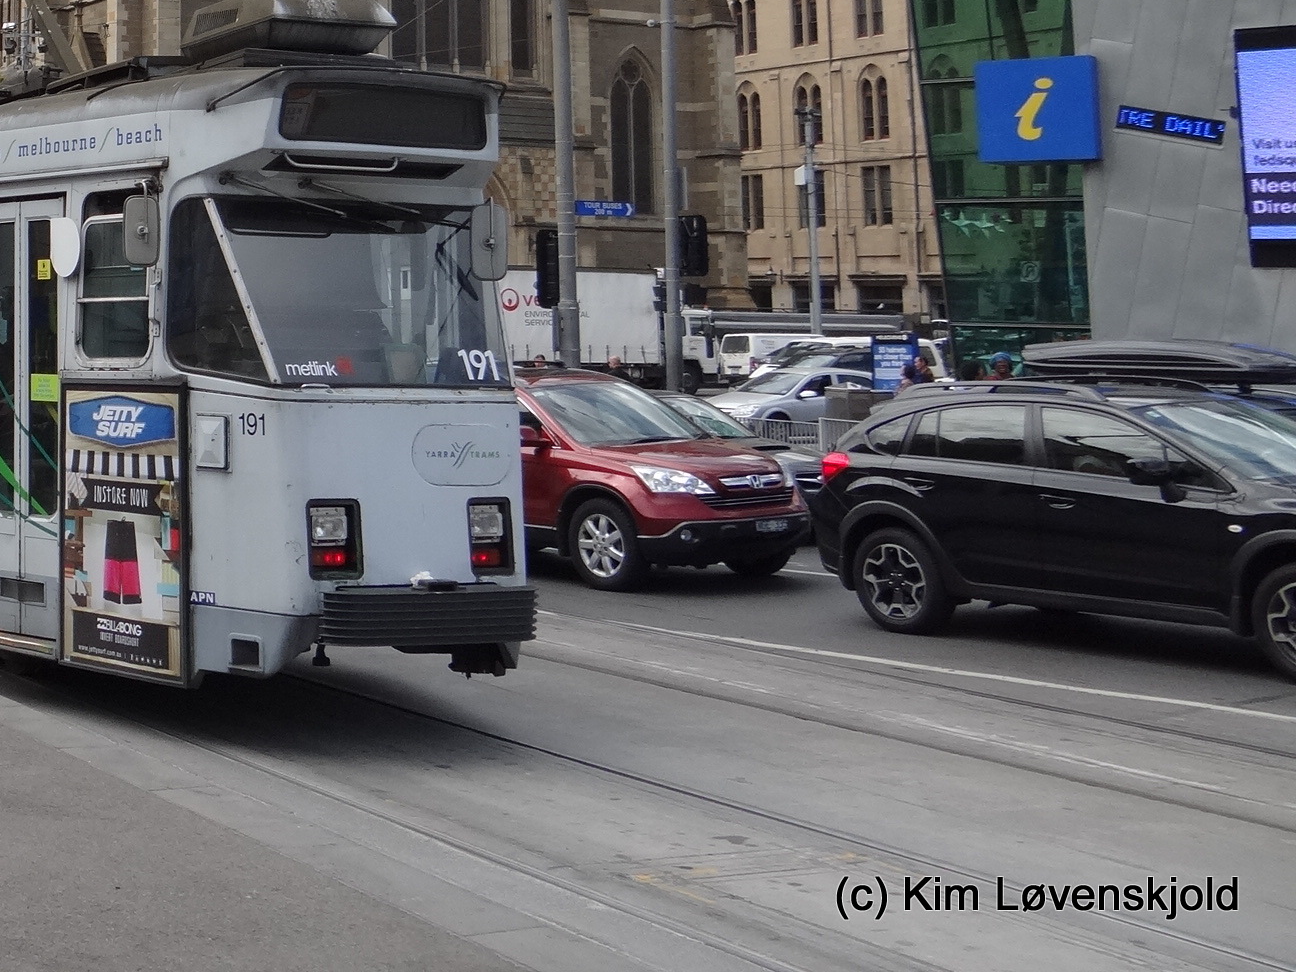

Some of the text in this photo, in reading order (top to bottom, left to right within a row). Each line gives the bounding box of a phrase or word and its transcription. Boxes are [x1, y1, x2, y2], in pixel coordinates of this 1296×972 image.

[1165, 116, 1225, 140] DAIL
[18, 135, 97, 158] melbourne
[116, 123, 163, 147] beach
[584, 201, 622, 210] TOUR BUSES
[285, 359, 338, 377] metlink
[458, 348, 500, 381] 191
[93, 405, 145, 422] JETTY
[95, 421, 146, 438] SURF
[238, 412, 266, 436] 191
[425, 450, 501, 459] YARRA TRAMS
[93, 485, 149, 508] INSTORE NOW
[191, 591, 215, 604] APN
[105, 618, 143, 637] BILLABONG
